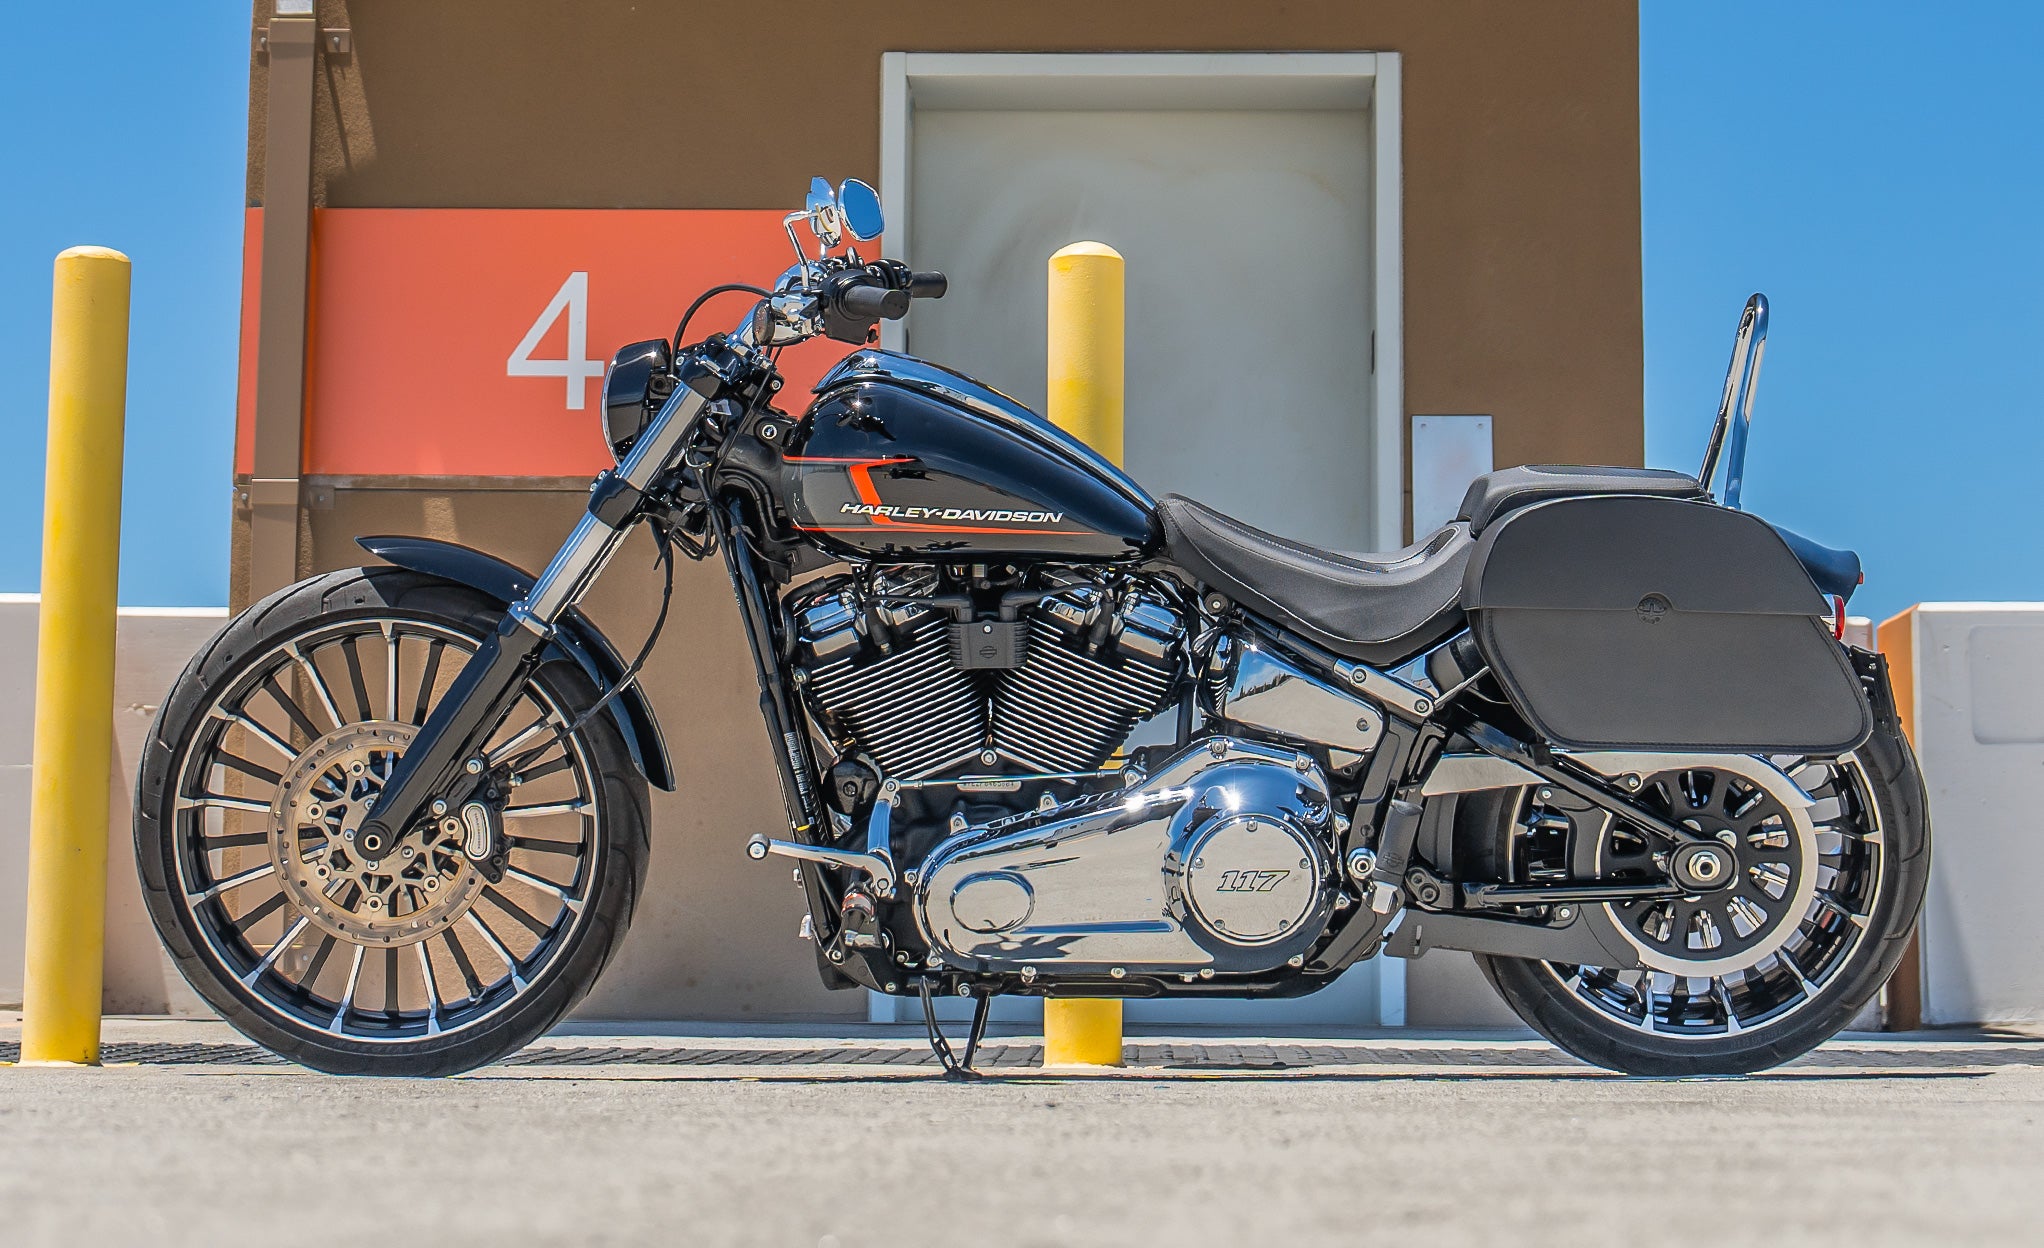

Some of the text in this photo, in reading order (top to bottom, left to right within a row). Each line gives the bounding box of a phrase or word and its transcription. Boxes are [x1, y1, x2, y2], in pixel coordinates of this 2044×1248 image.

[507, 271, 605, 410] 4
[840, 502, 1063, 523] HARLEY-DAVIDSON
[1216, 869, 1291, 892] 117
